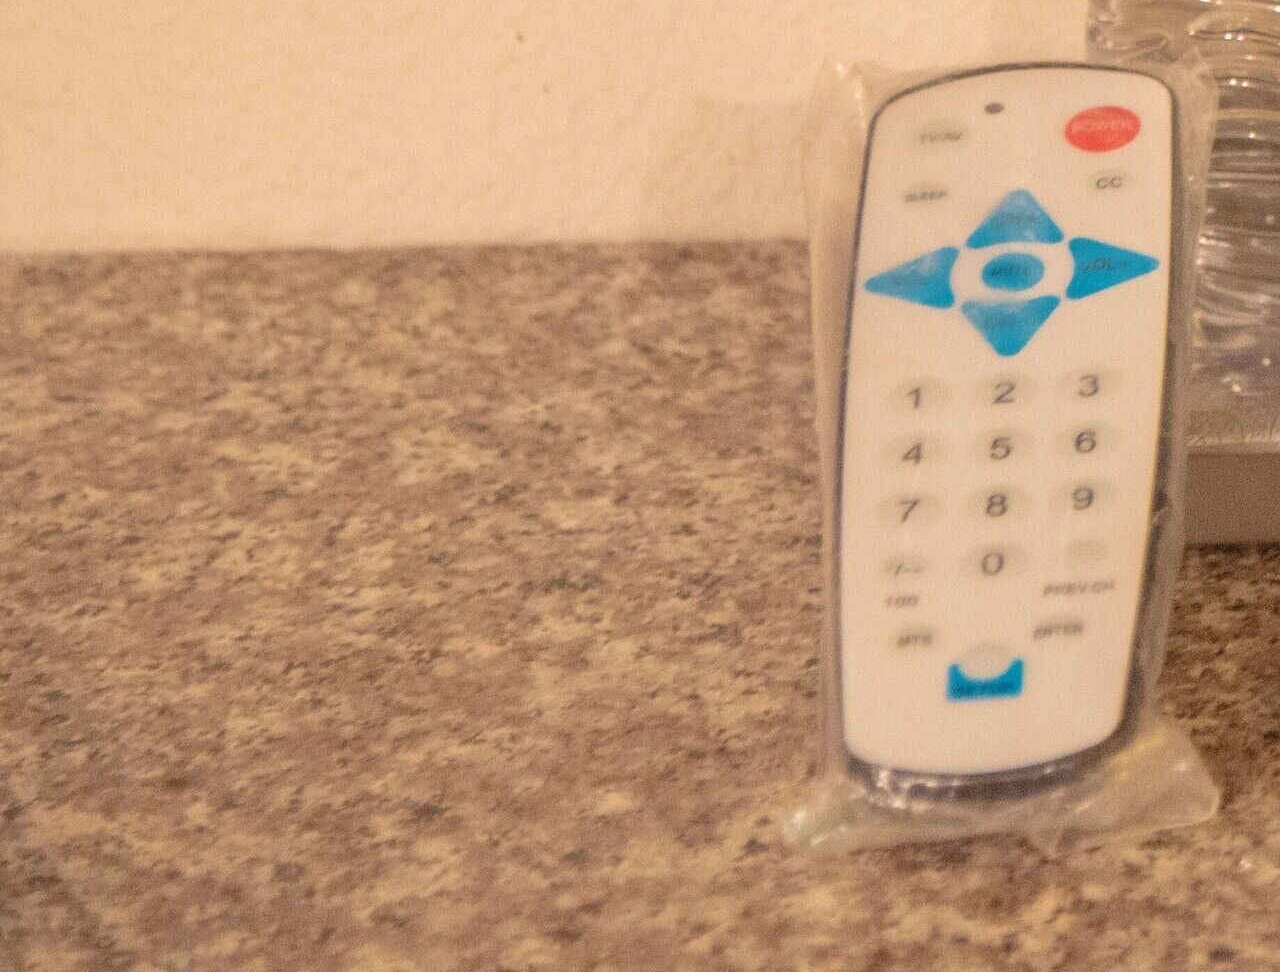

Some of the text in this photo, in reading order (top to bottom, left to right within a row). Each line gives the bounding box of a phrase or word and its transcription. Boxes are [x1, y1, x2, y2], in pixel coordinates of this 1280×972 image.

[1095, 177, 1122, 191] CC
[907, 386, 922, 409] 1
[993, 380, 1016, 404] 2
[1077, 374, 1100, 398] 3
[902, 442, 922, 465] 4
[990, 436, 1012, 461] 5
[1074, 430, 1096, 454] 6
[898, 498, 921, 523] 7
[985, 493, 1009, 518] 8
[1072, 486, 1095, 511] 9
[981, 551, 1005, 577] 0
